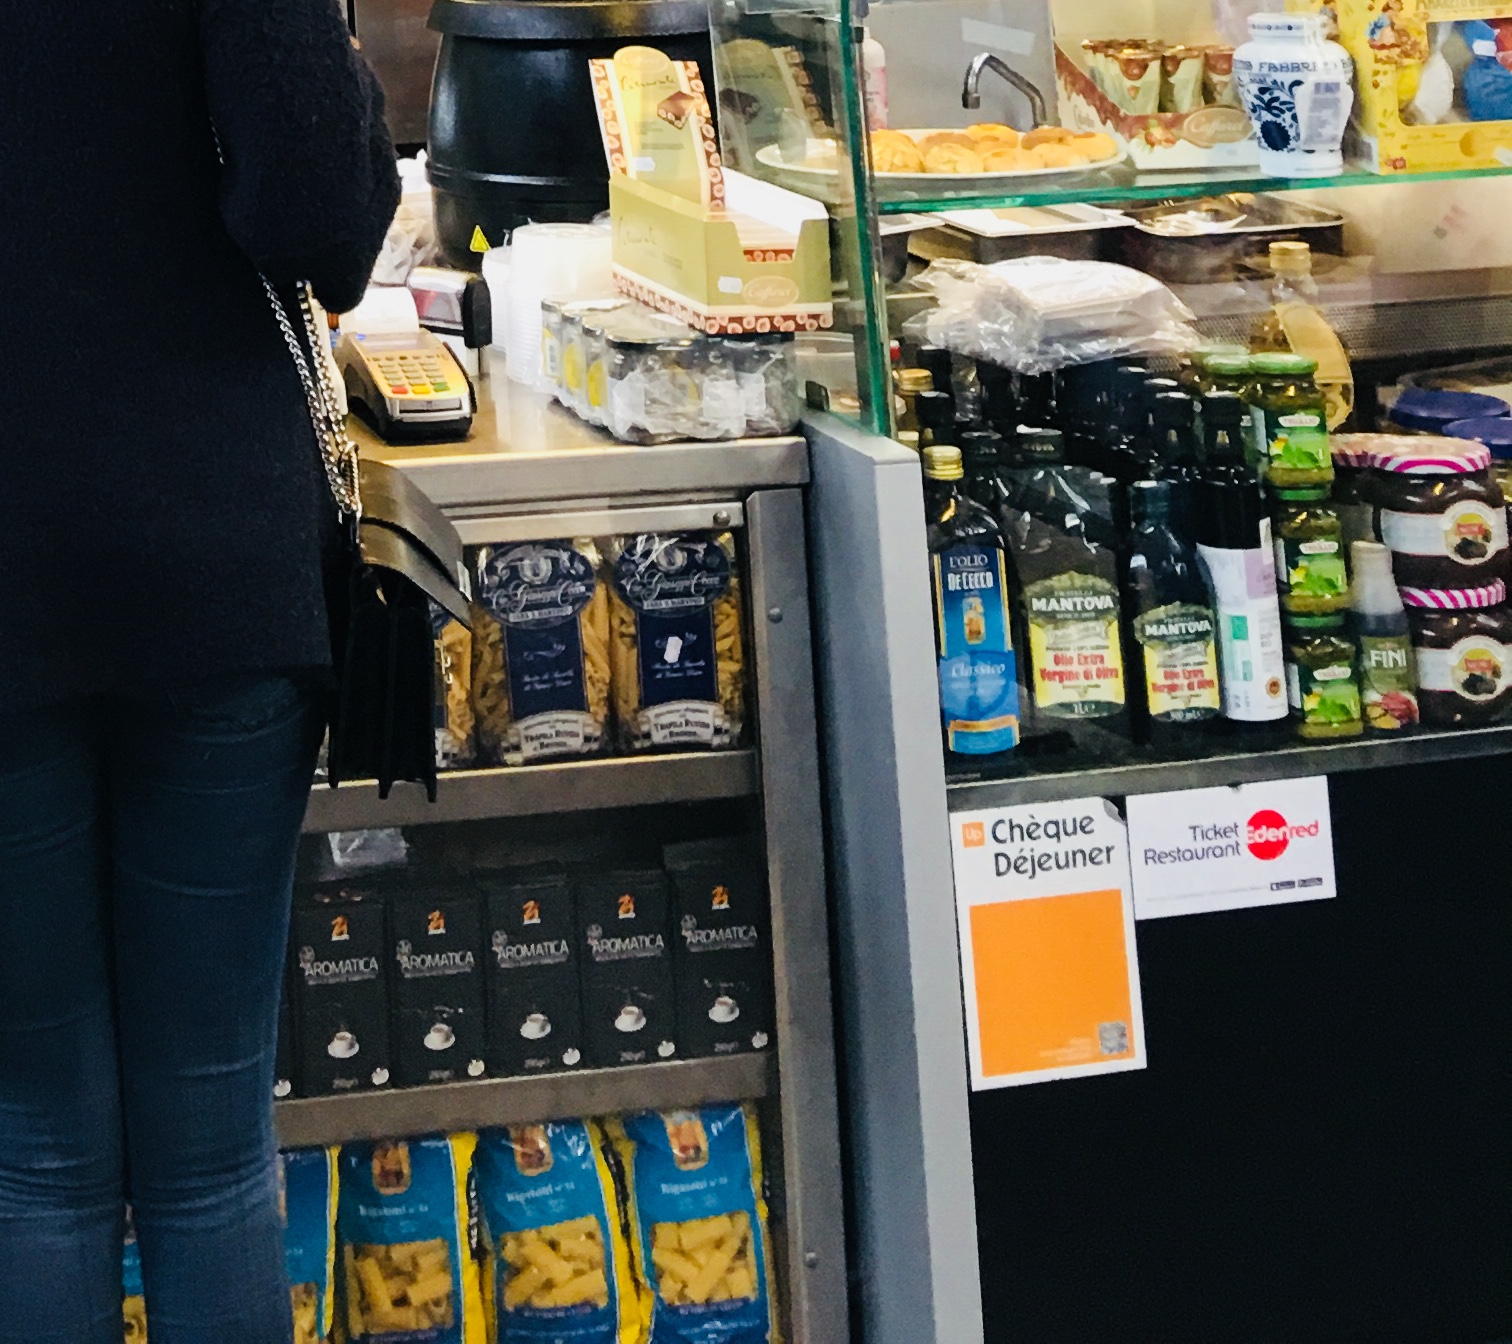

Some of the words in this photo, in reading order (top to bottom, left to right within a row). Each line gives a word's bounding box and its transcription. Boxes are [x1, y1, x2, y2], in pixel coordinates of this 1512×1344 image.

[1031, 595, 1115, 612] MANTOVA
[1144, 620, 1212, 637] MANTOVA
[1370, 649, 1406, 667] FINI
[991, 813, 1095, 847] Chèque
[1188, 822, 1241, 842] Ticket
[994, 844, 1115, 879] Déjeuner
[1143, 840, 1242, 866] Restaurant
[592, 934, 665, 953] AROMATICA
[687, 925, 758, 944] AROMATICA
[497, 939, 569, 960] AROMATICA
[305, 957, 379, 977] AROMATICA
[402, 951, 475, 970] AROMATICA
